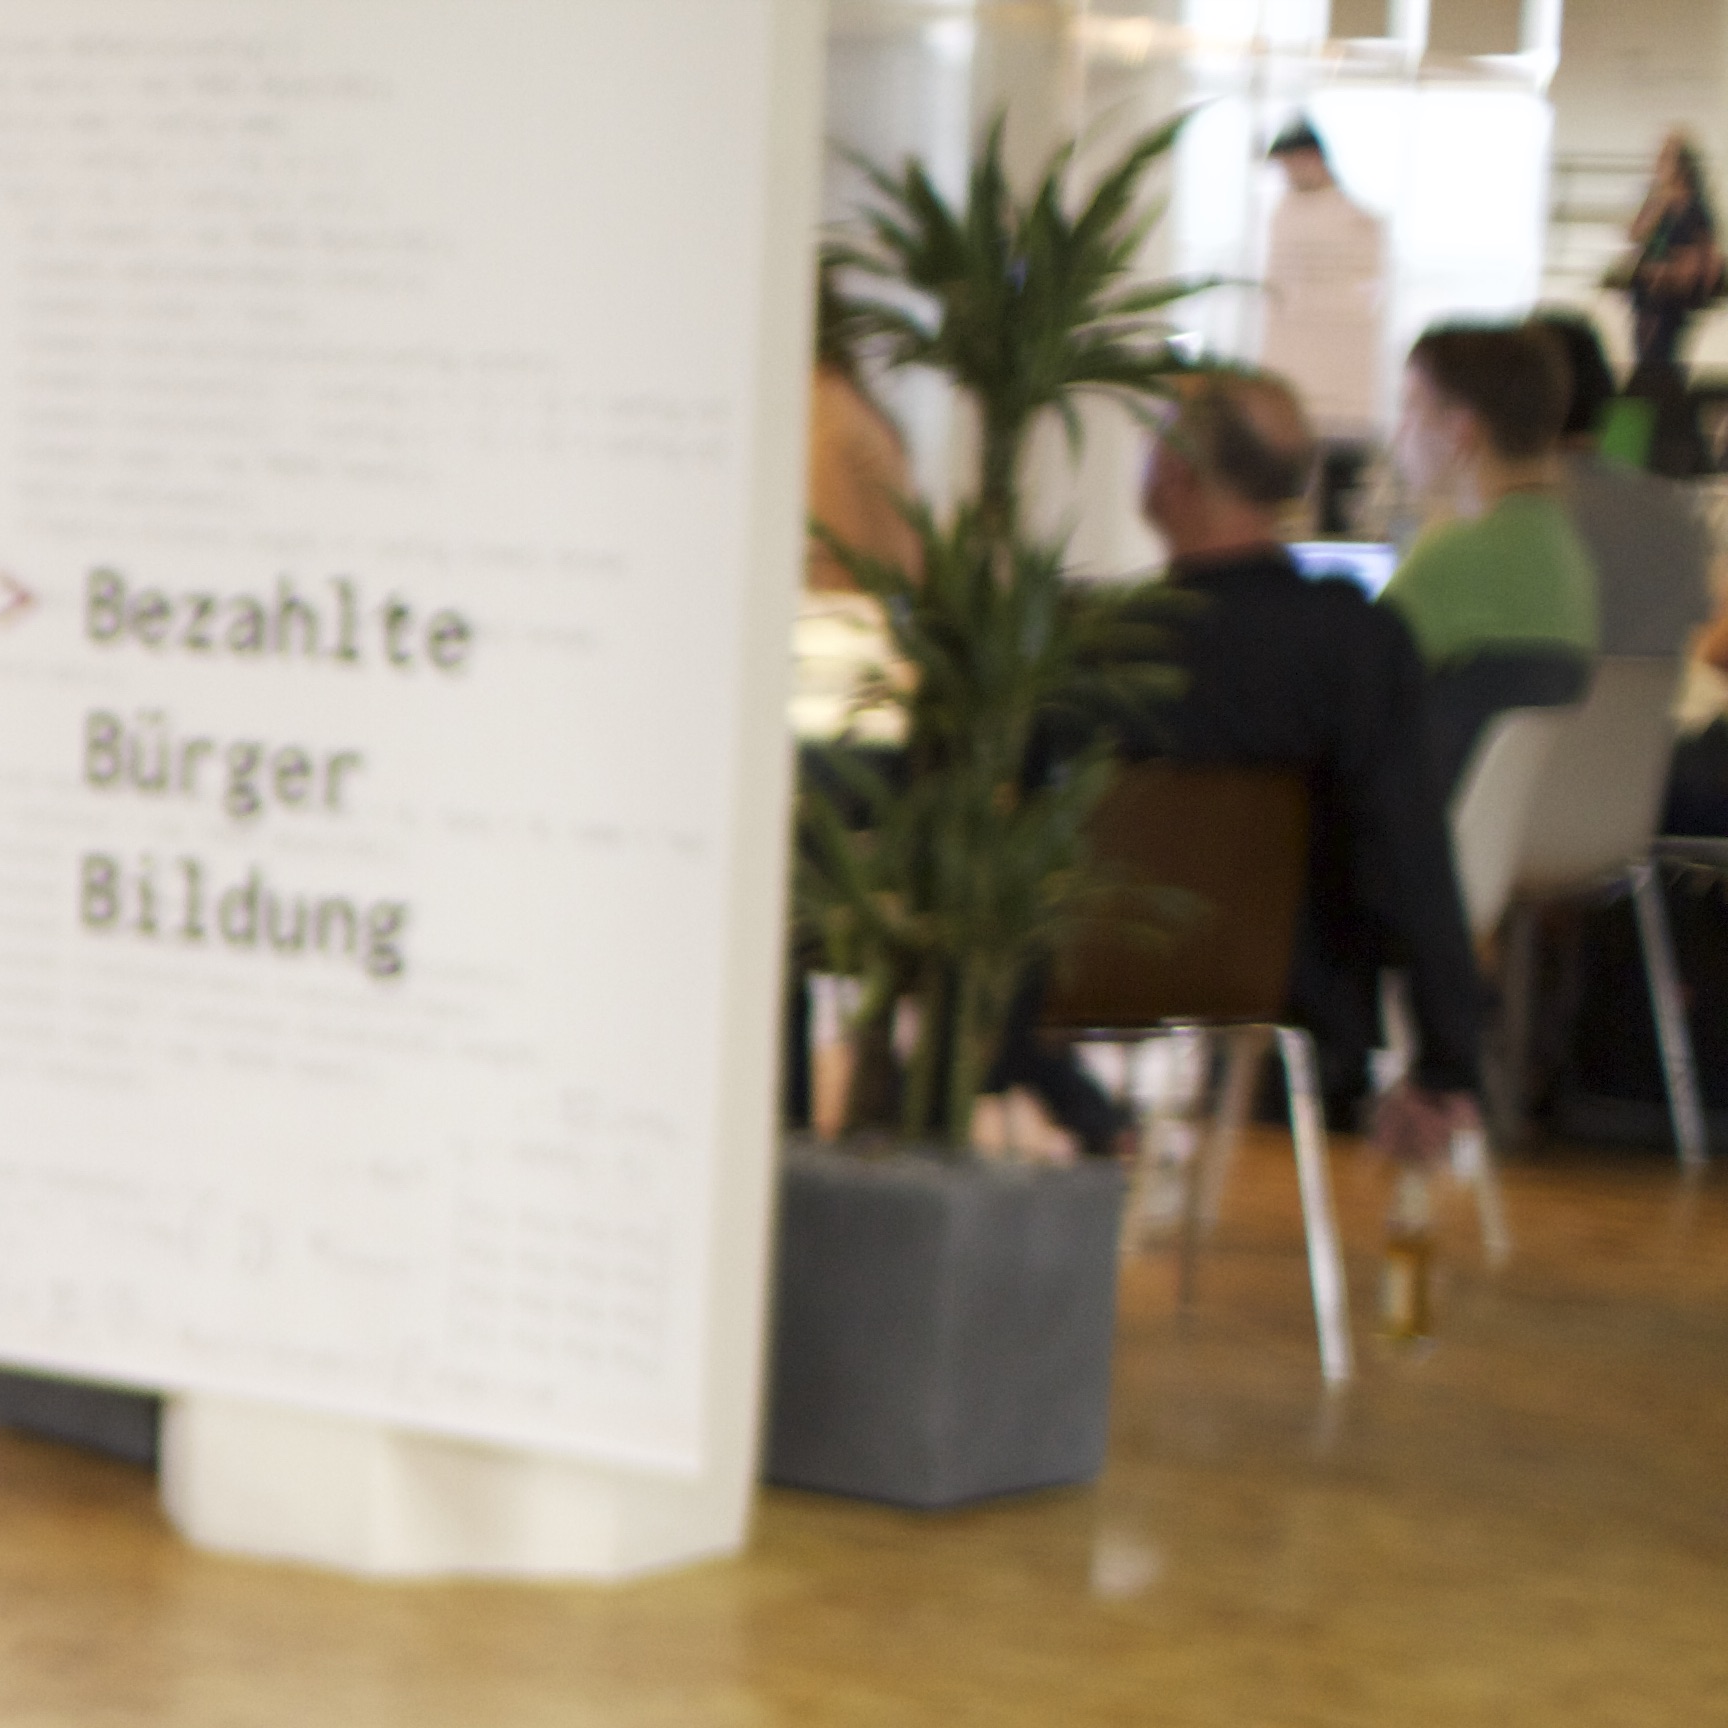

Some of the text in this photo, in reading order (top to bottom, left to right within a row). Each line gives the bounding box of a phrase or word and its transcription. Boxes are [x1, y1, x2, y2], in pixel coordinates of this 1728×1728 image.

[85, 567, 473, 673] Bezahlte
[83, 707, 363, 820] Bürger
[78, 849, 410, 980] Bildung
